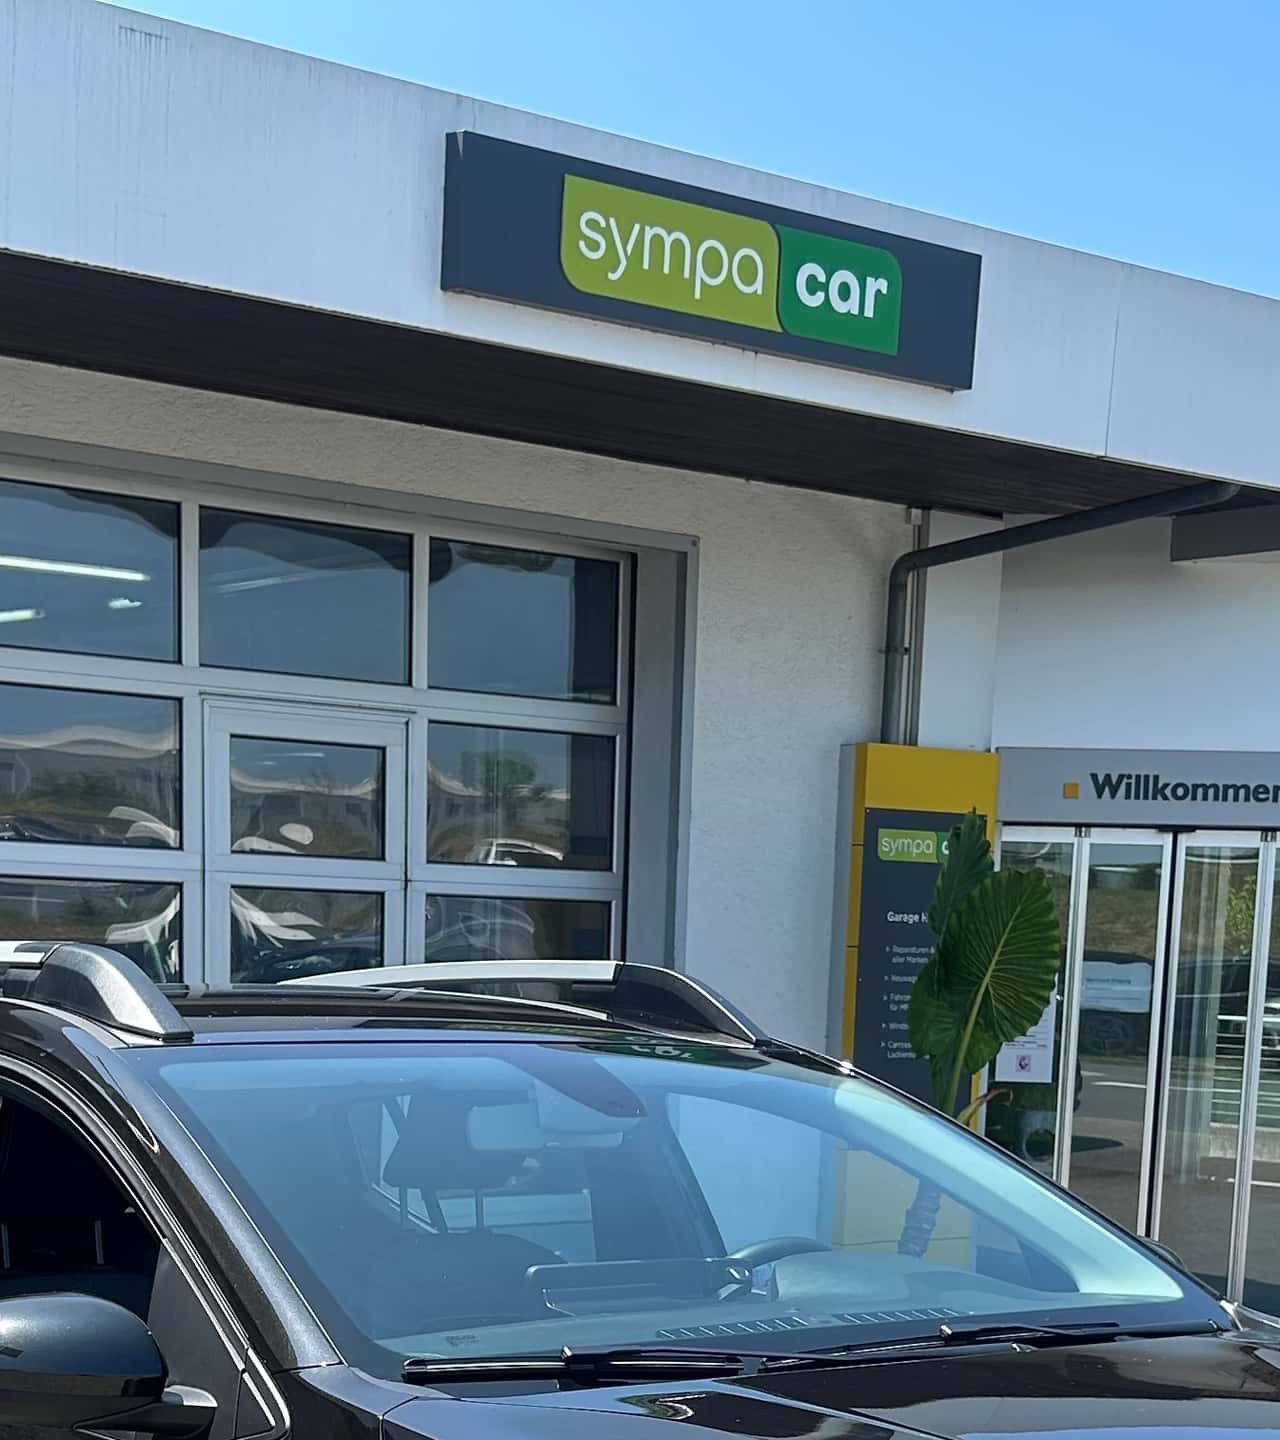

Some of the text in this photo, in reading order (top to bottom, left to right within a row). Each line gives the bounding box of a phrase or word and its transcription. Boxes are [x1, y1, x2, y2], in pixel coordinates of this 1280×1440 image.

[578, 210, 888, 319] sympa car
[881, 838, 933, 857] sympa
[887, 911, 920, 924] Garage
